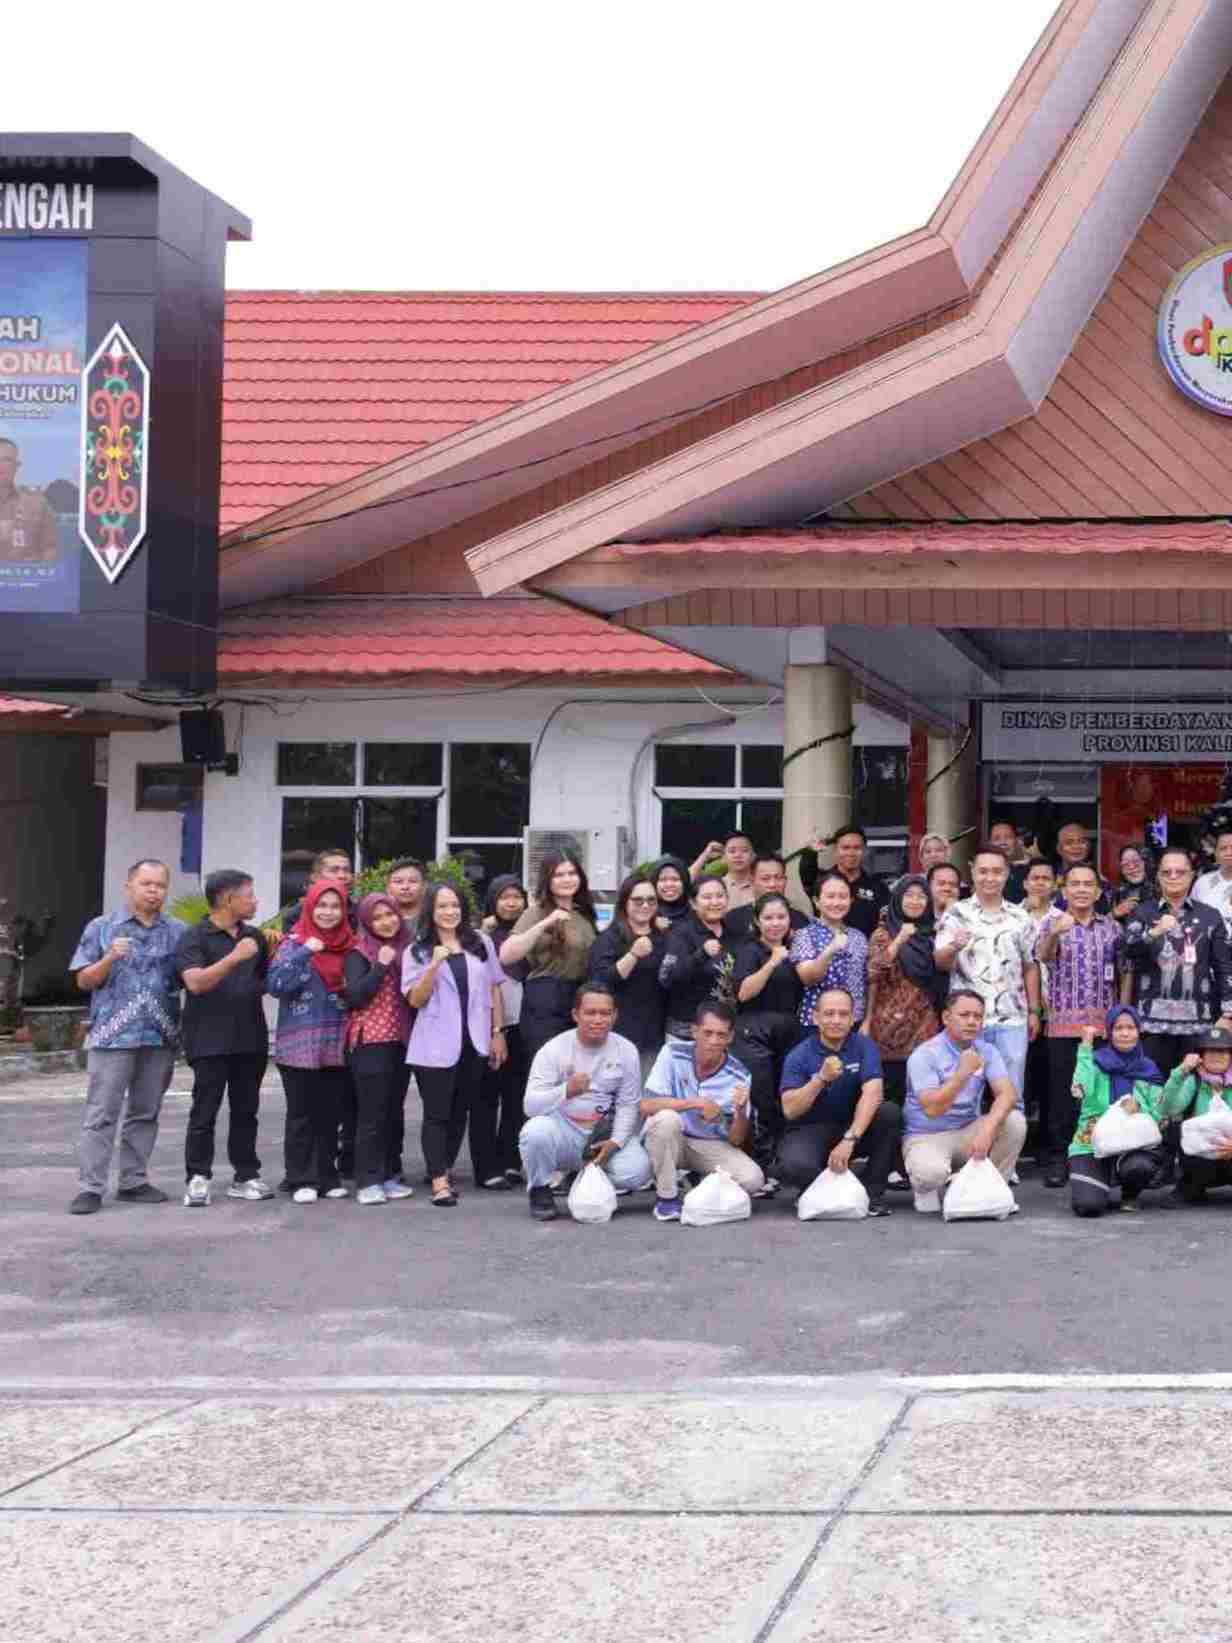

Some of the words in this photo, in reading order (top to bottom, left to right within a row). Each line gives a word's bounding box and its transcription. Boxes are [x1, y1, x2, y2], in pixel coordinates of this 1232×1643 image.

[0, 183, 94, 230] NGAH
[1001, 711, 1066, 729] DINAS
[1083, 734, 1179, 752] PROVINSI
